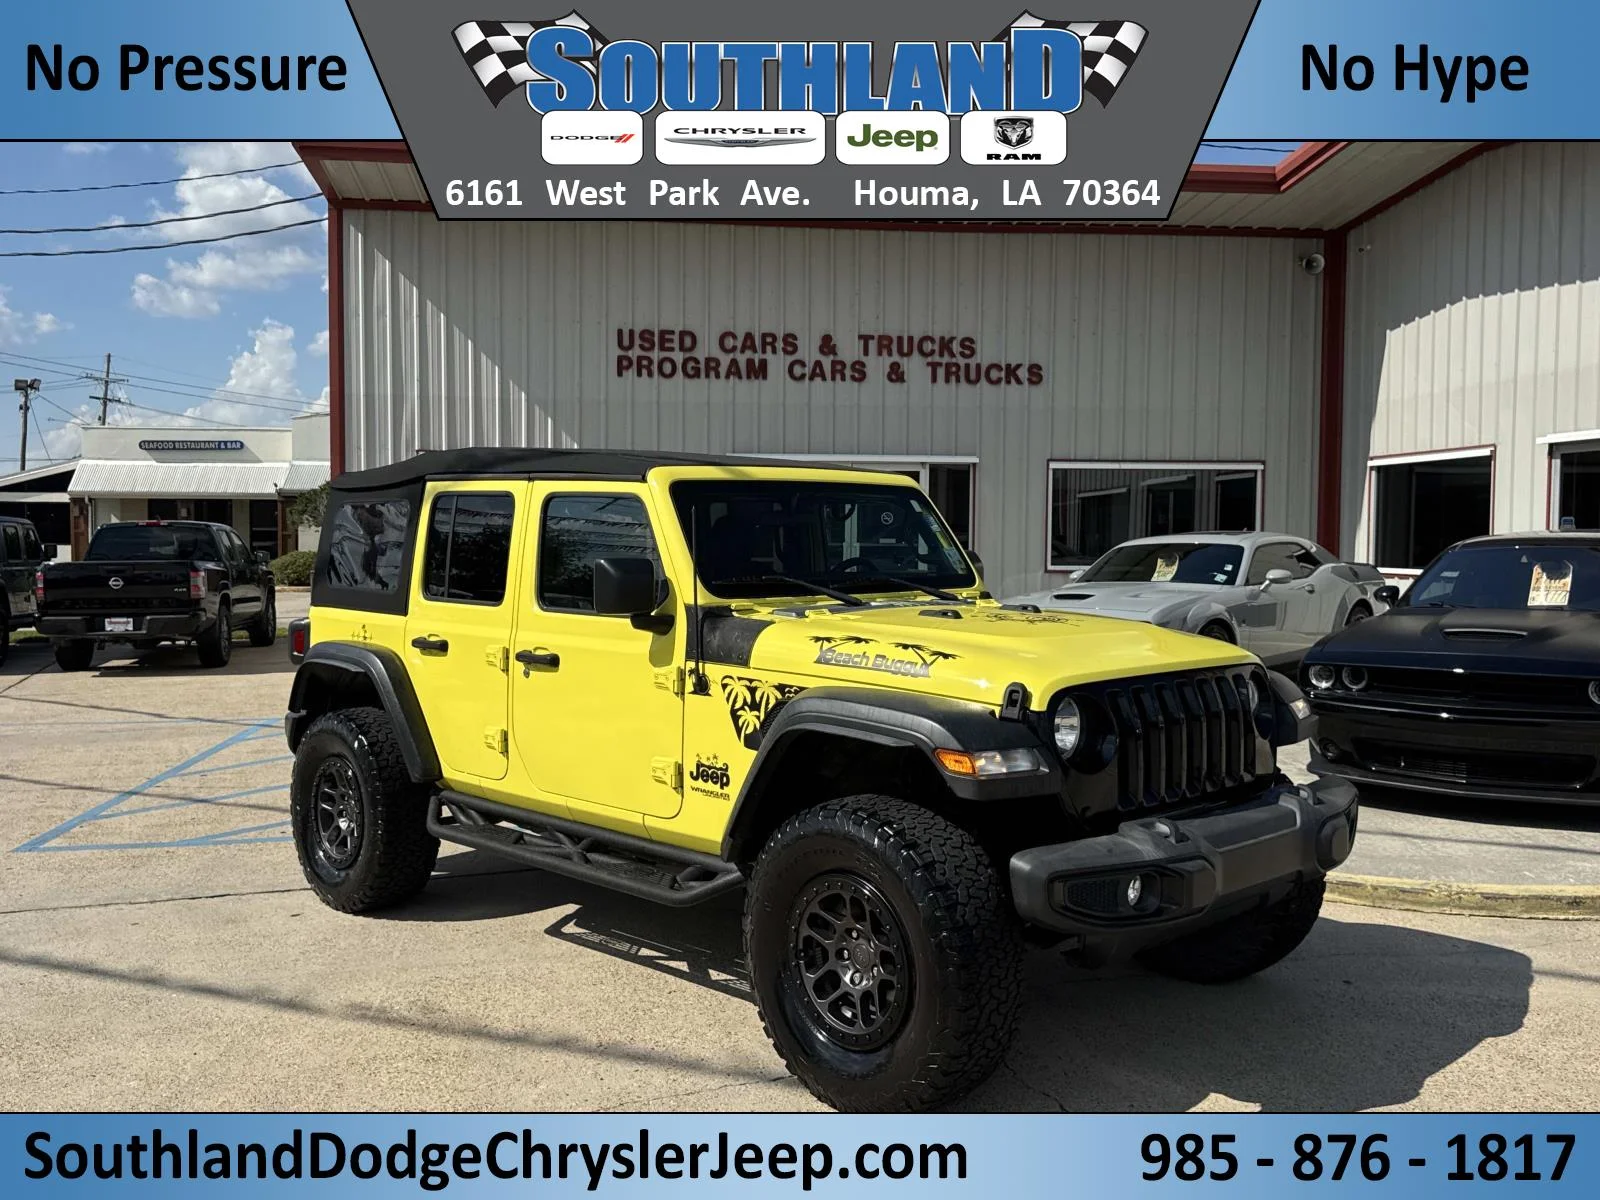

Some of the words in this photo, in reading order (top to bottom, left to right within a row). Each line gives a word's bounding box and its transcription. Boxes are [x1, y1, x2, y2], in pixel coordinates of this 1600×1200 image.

[616, 328, 698, 352] USED
[718, 331, 799, 355] CARS
[818, 334, 838, 356] &
[858, 334, 977, 359] TRUCKS
[616, 354, 768, 381] PROGRAM
[787, 359, 867, 383] CARS
[886, 362, 906, 384] &
[926, 361, 1044, 386] TRUCKS
[141, 441, 174, 449] SEAFOOD
[175, 441, 218, 449] RESTAURANT
[227, 441, 241, 449] BAR
[824, 648, 870, 667] Beach
[872, 653, 926, 679] Buggy
[689, 761, 731, 791] Jeep
